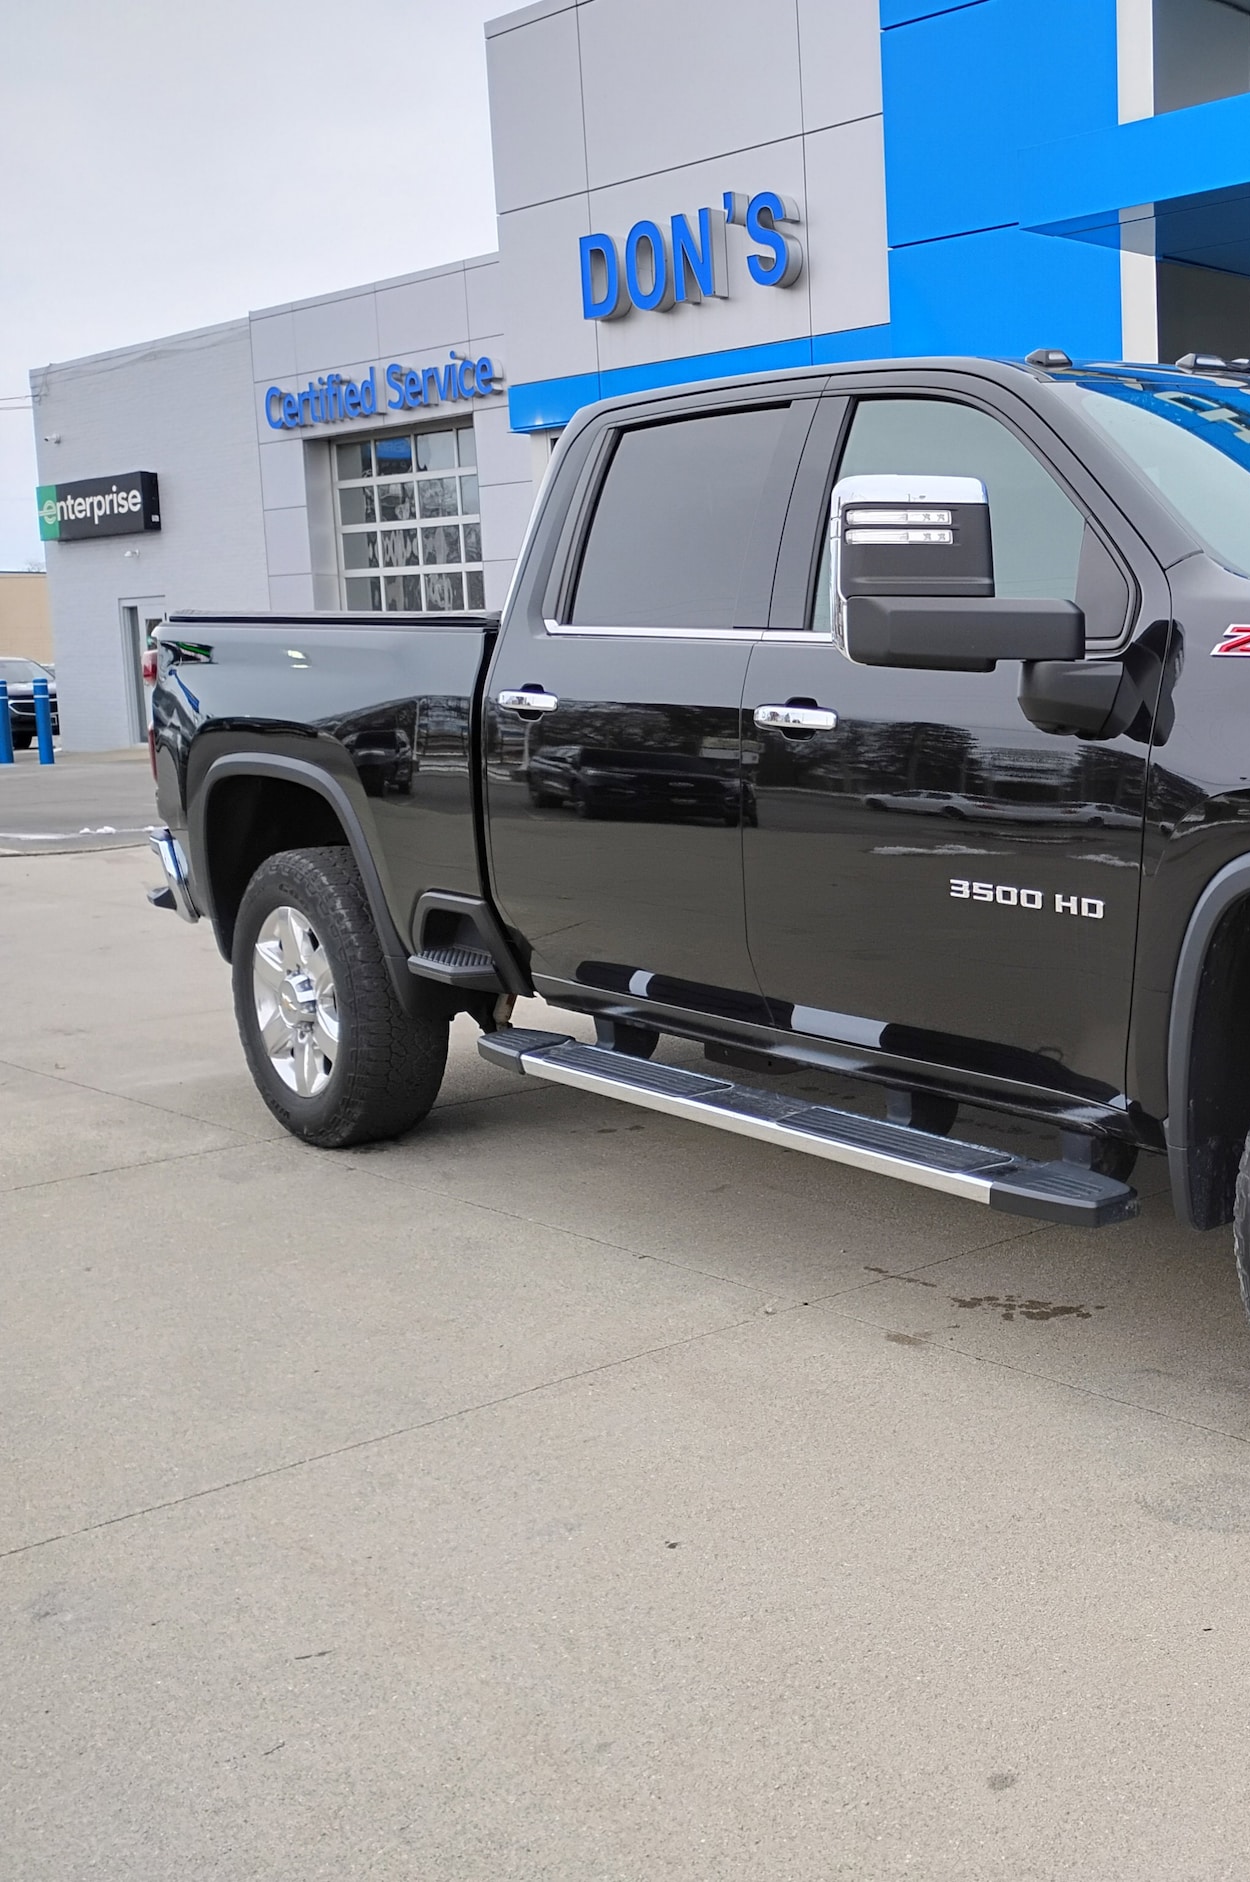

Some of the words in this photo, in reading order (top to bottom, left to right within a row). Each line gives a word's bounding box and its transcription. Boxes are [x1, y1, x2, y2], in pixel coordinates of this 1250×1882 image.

[579, 190, 797, 321] DON'S
[265, 366, 380, 430] Certified
[386, 350, 498, 410] Service
[38, 485, 142, 525] enterprise
[950, 878, 1043, 910] 3500
[1055, 893, 1104, 919] HD
